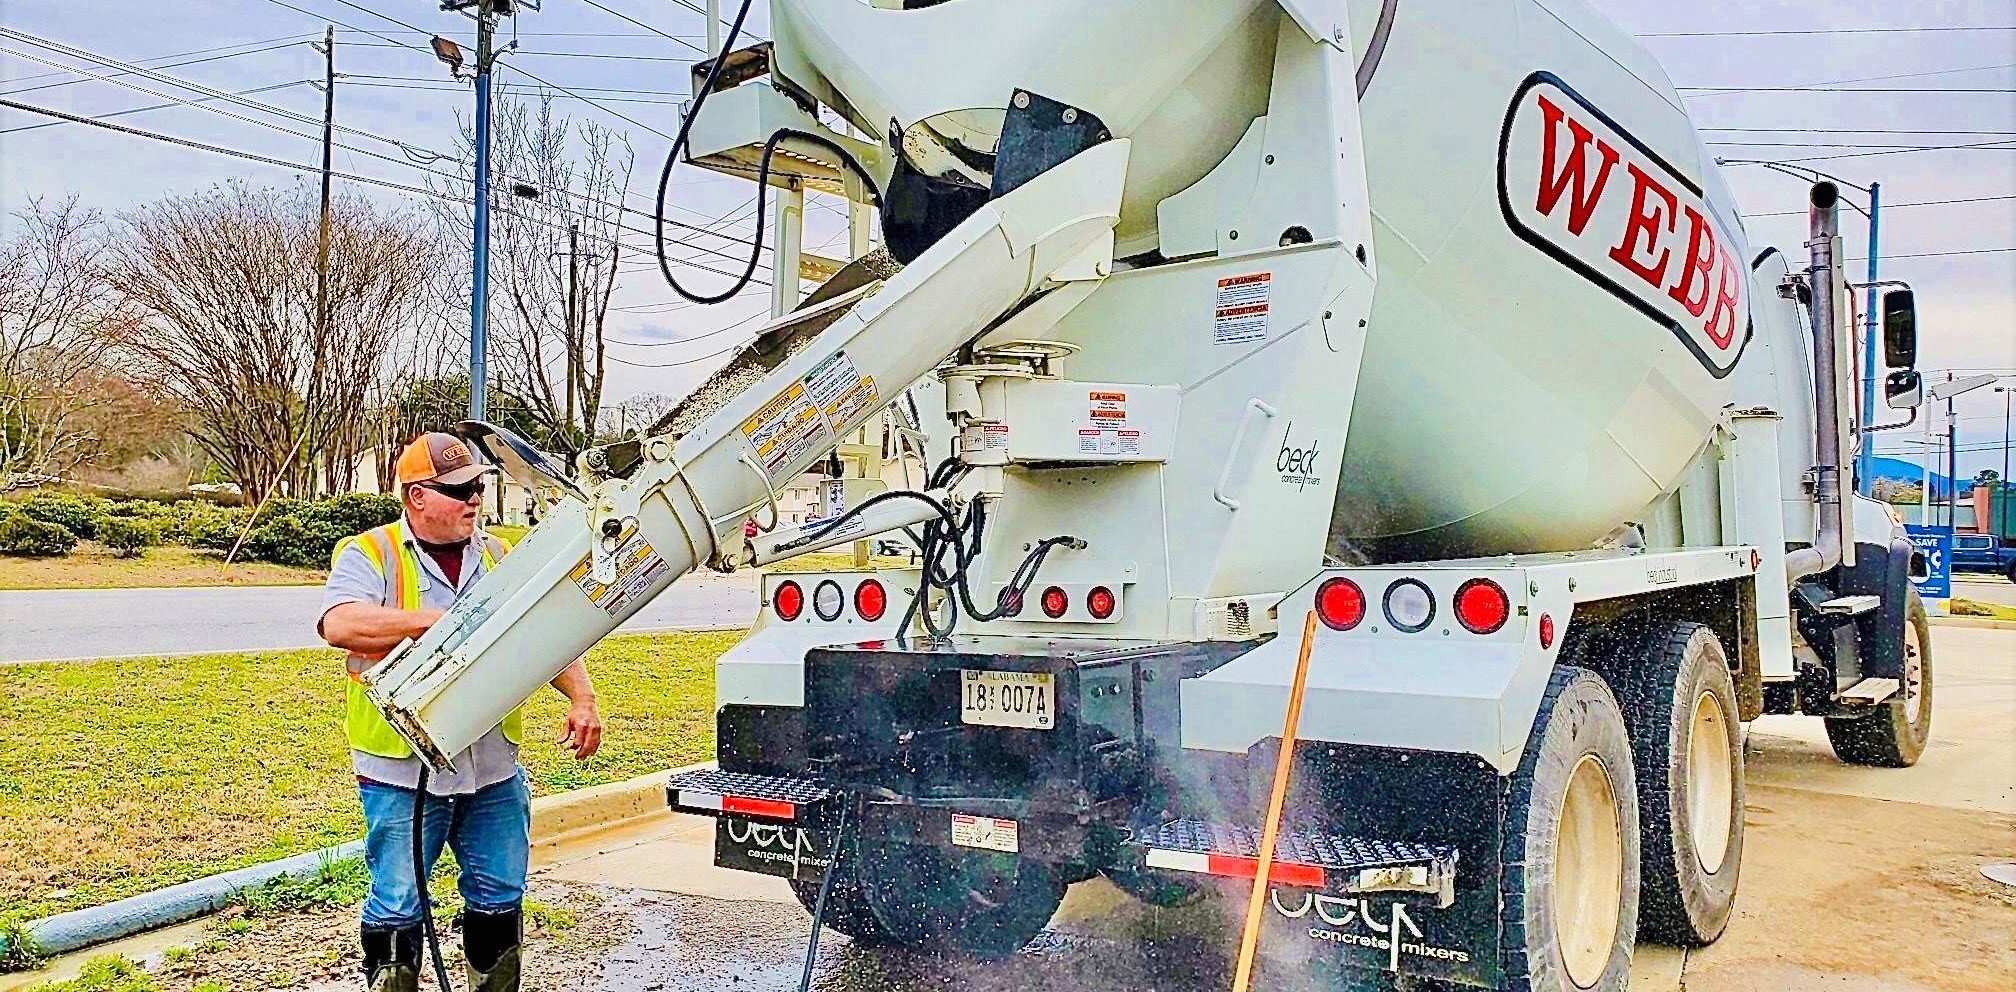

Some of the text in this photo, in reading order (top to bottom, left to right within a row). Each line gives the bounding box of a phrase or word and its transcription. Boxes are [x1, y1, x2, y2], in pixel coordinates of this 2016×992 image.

[1535, 93, 1739, 351] WEBB
[762, 395, 791, 418] CAUTION
[1277, 420, 1320, 493] beck
[1915, 538, 1938, 547] SAVE
[988, 672, 1030, 682] ALABAMA
[966, 684, 987, 712] 18
[1001, 684, 1046, 715] 007A
[747, 849, 794, 863] concrete
[1308, 926, 1470, 963] concrete mixers
